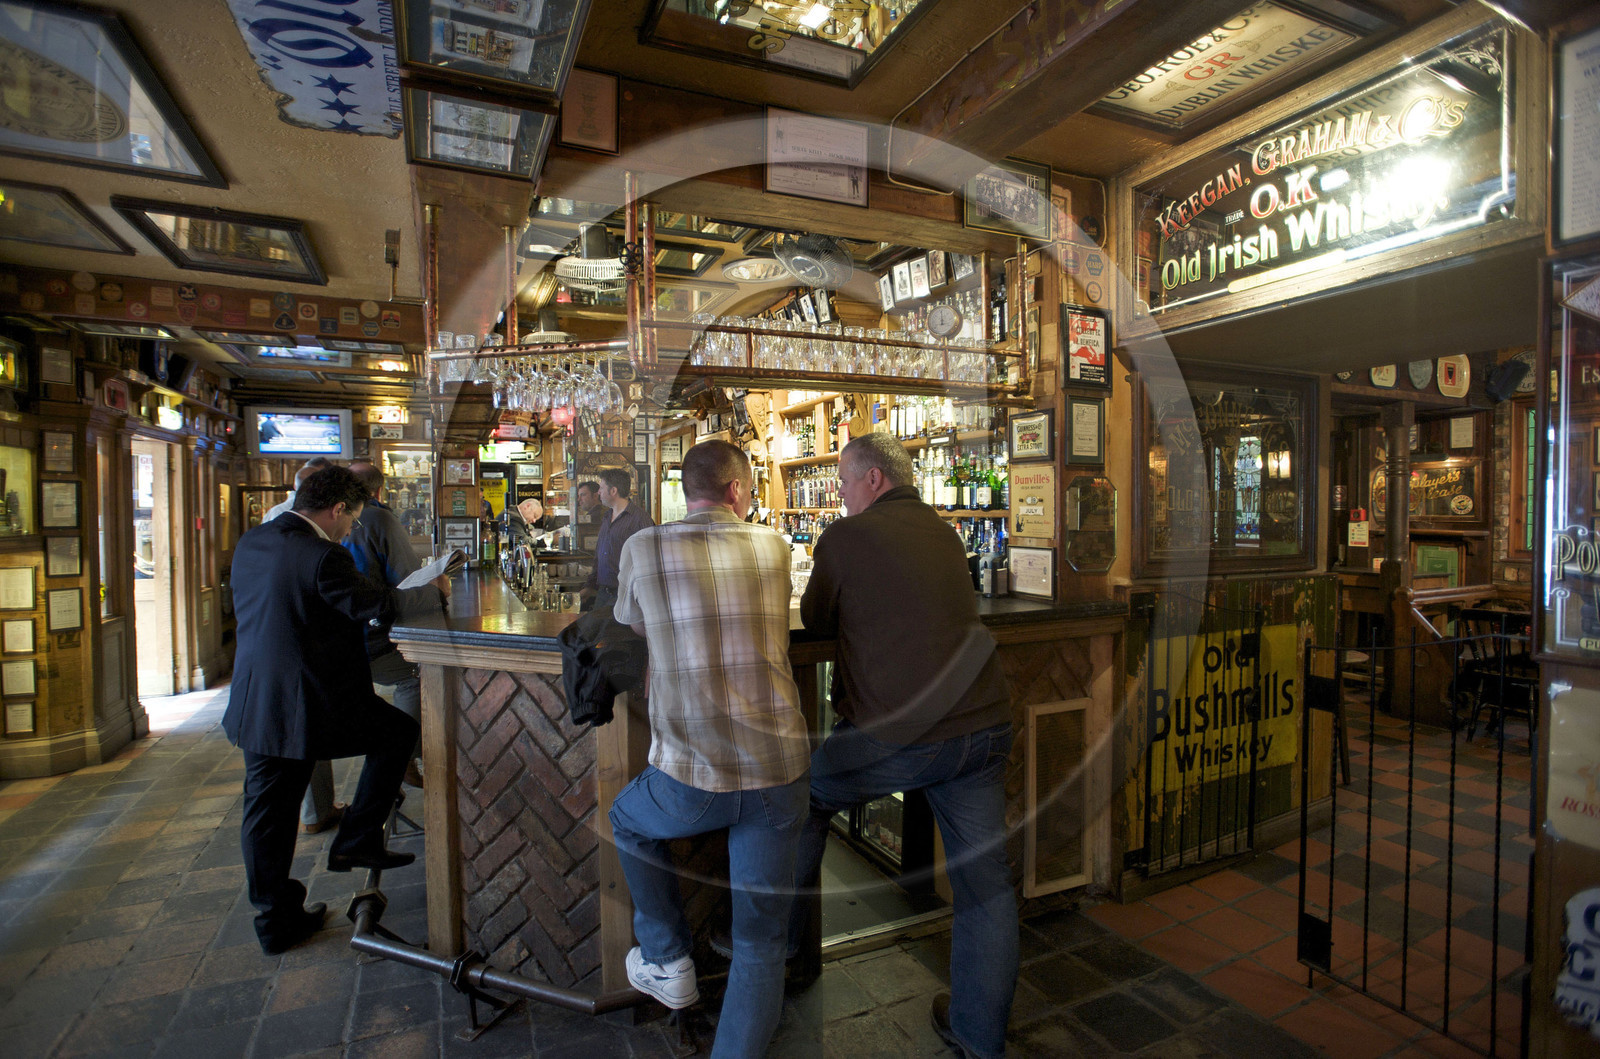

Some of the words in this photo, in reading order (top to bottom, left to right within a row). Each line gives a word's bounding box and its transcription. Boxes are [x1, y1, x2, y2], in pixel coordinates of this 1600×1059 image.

[376, 0, 397, 51] LNDON
[1184, 50, 1244, 82] GR
[1156, 79, 1238, 120] DUBLIN
[1251, 109, 1373, 176] GRAHAM
[1161, 246, 1202, 291] Old
[1207, 224, 1280, 283] Irish
[1015, 474, 1050, 485] Dunville's
